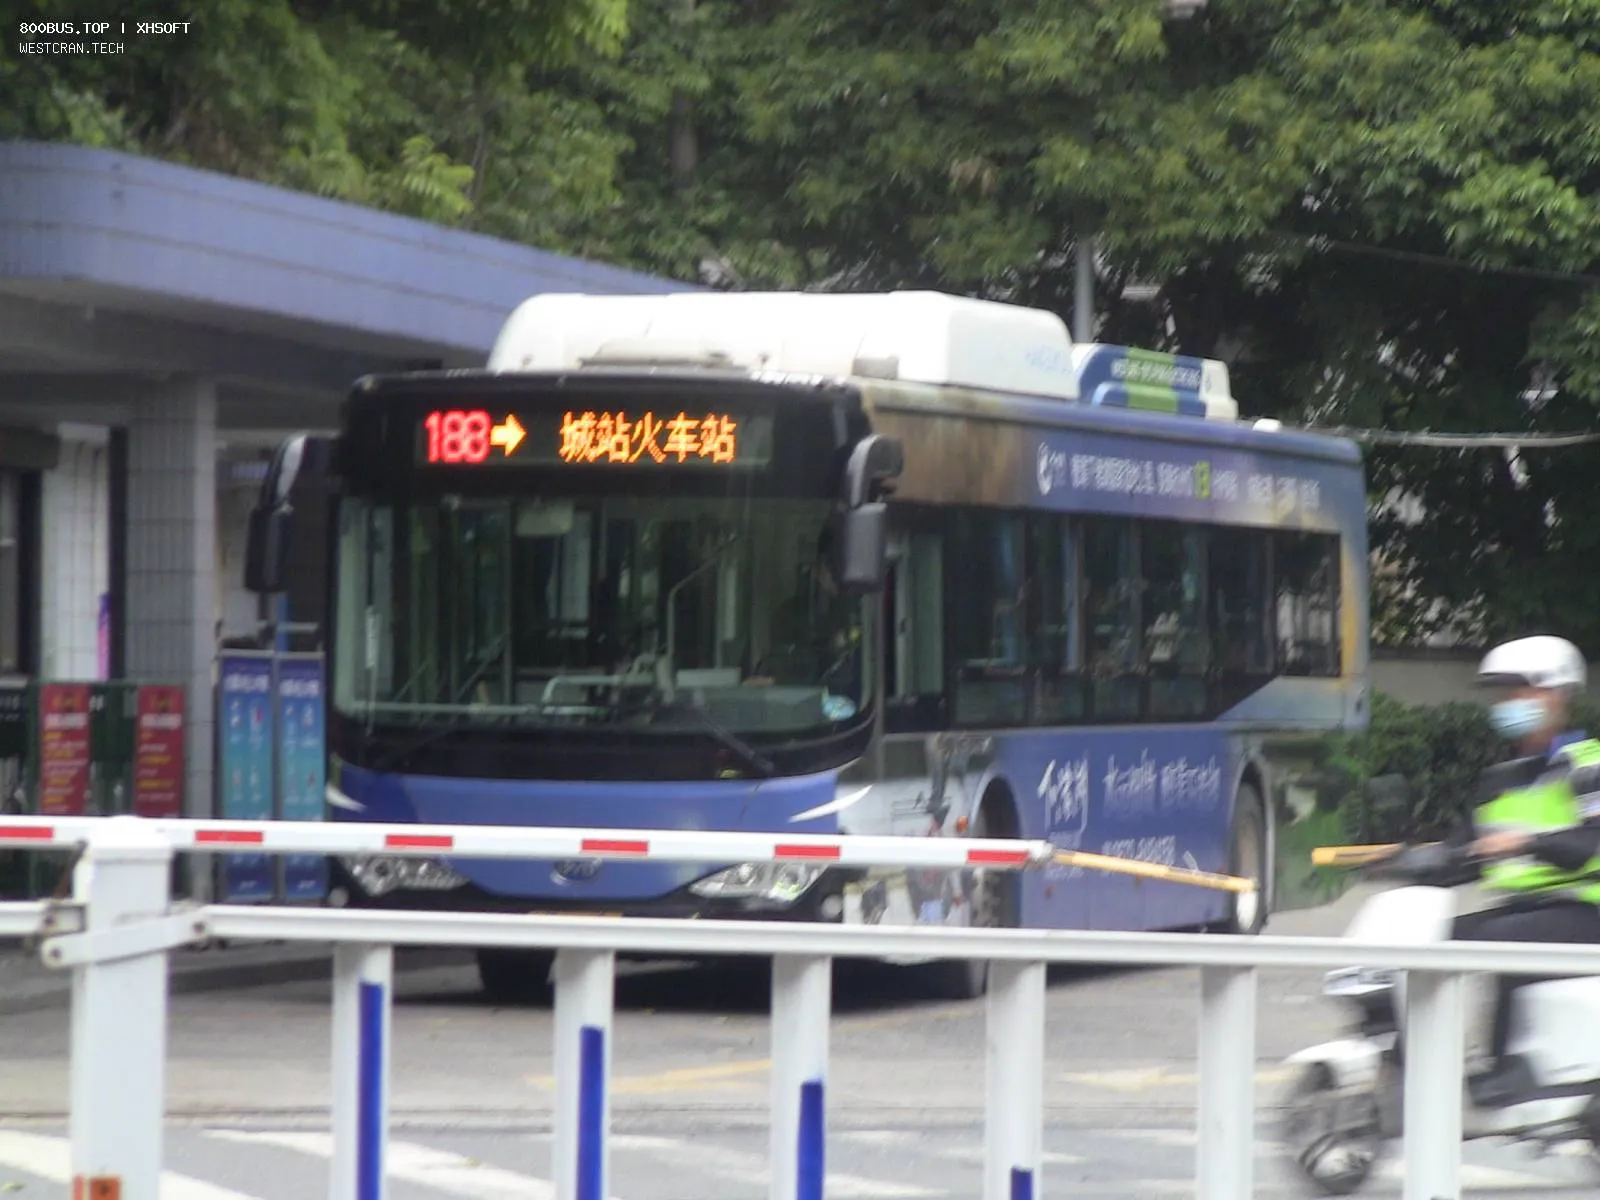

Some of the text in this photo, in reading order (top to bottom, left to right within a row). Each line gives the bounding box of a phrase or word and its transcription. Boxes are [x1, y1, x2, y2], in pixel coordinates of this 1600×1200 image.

[558, 411, 737, 464] 城站火车站
